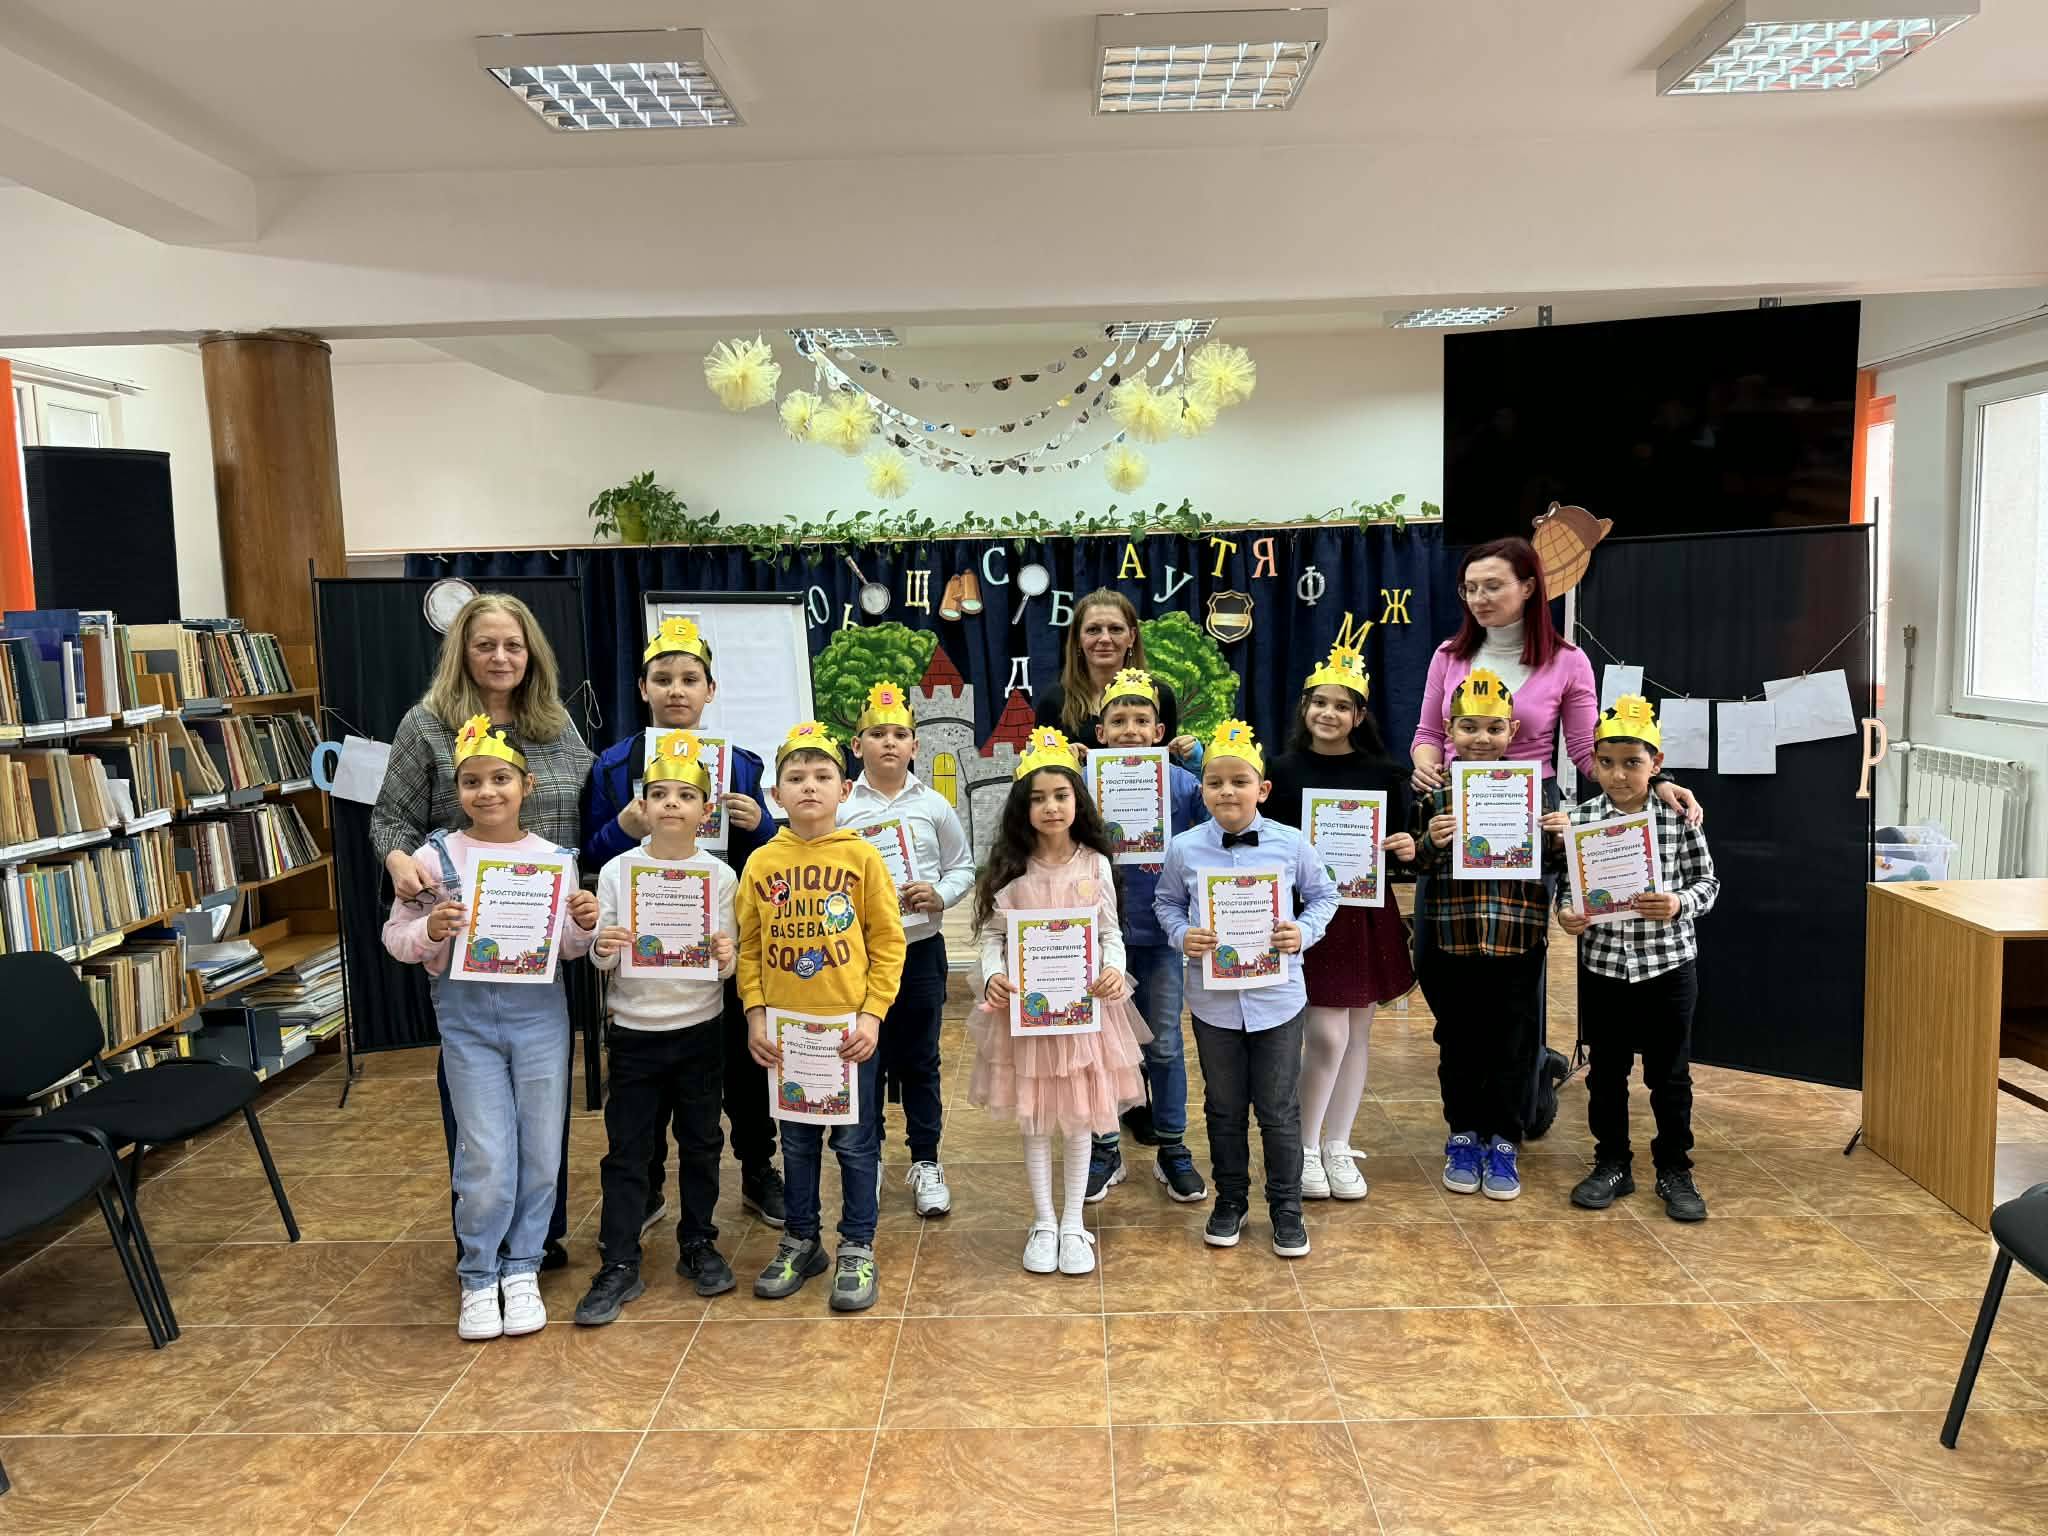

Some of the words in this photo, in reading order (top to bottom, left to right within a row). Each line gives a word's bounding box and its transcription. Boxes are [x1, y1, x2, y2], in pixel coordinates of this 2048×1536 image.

[982, 547, 1010, 586] С
[1117, 543, 1147, 579] А
[1209, 537, 1237, 578] Т
[1251, 537, 1278, 578] Я
[906, 569, 931, 615] Щ
[1153, 564, 1194, 603] У
[1296, 565, 1326, 606] Ф
[807, 585, 830, 629] Ю
[1048, 589, 1074, 627] Б
[1380, 588, 1412, 624] Ж
[1332, 611, 1375, 656] М
[1004, 656, 1033, 699] Д
[1473, 680, 1488, 696] М
[1628, 703, 1641, 718] Е
[463, 726, 476, 742] А
[1229, 729, 1241, 741] Г
[1856, 718, 1888, 799] Р
[774, 897, 826, 919] JUNIO
[767, 940, 851, 972] SQAD
